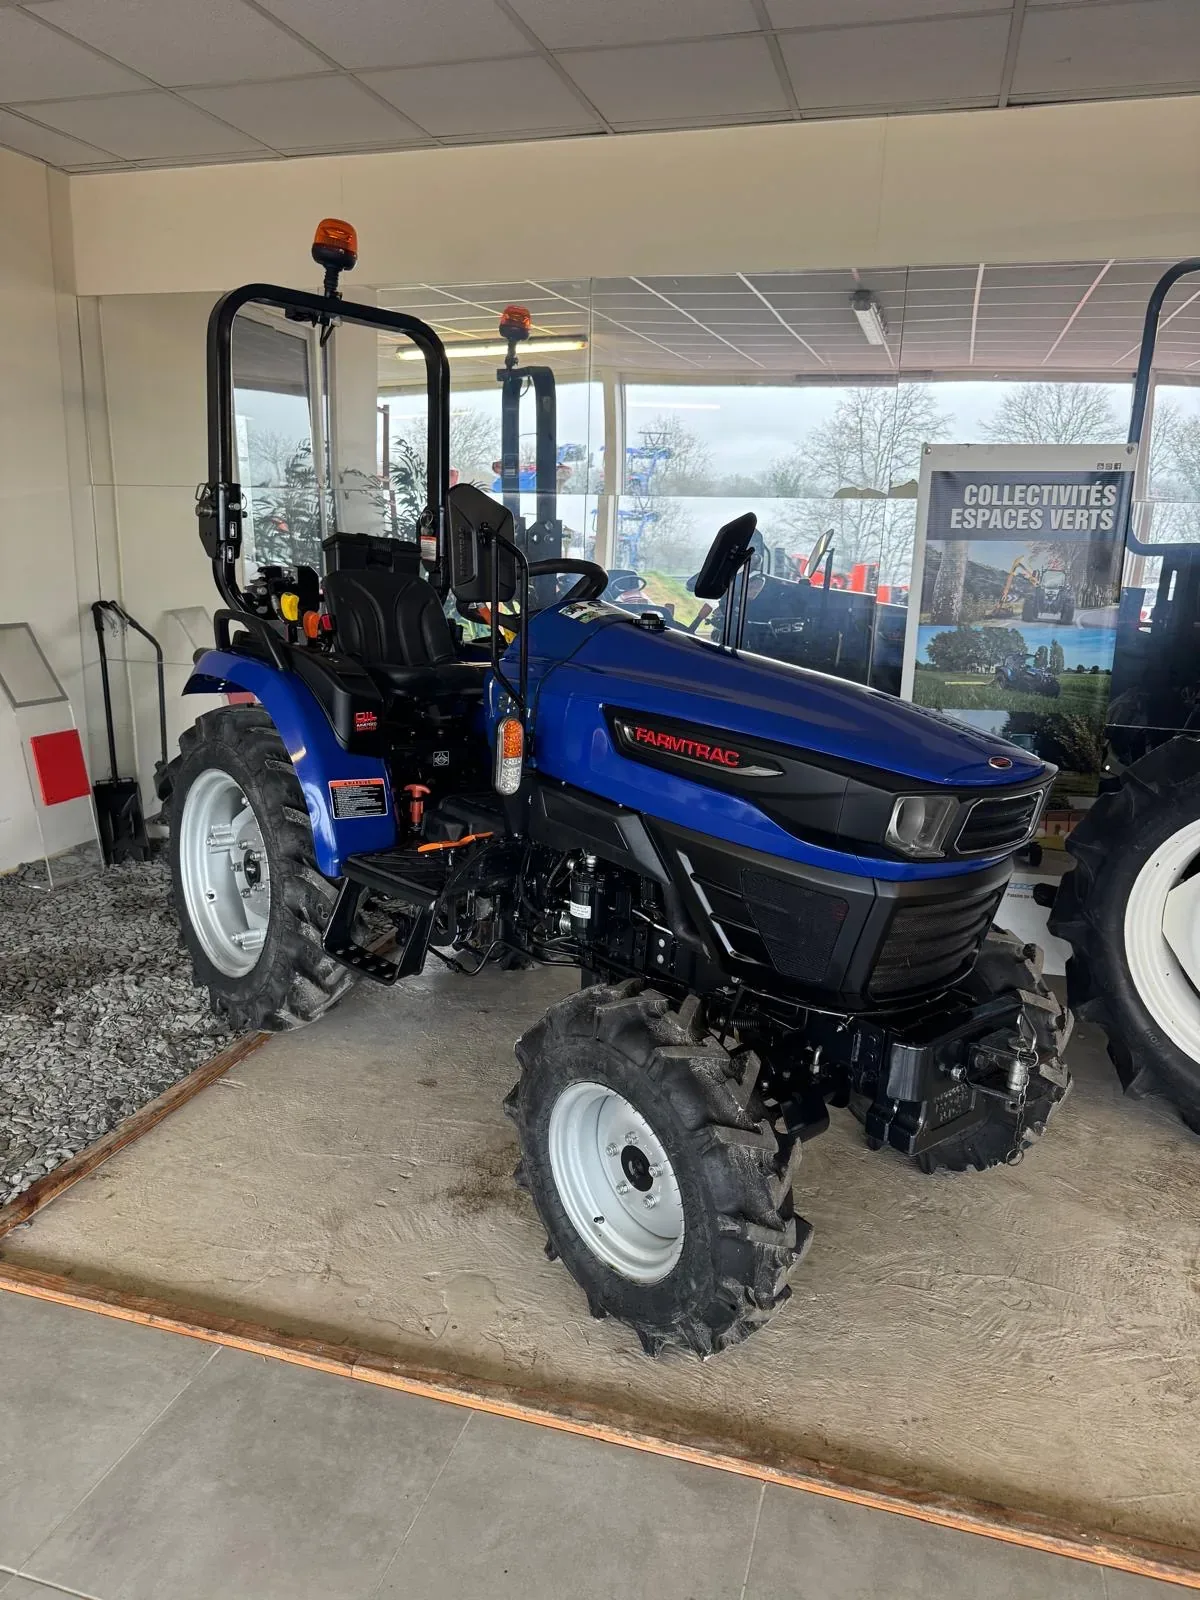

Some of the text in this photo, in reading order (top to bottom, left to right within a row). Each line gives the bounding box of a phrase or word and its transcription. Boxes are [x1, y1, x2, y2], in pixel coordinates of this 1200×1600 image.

[964, 481, 1117, 506] COLLECTIVITÉS
[950, 508, 1114, 530] ESPACES VERTS
[635, 727, 740, 767] FARMTRAC
